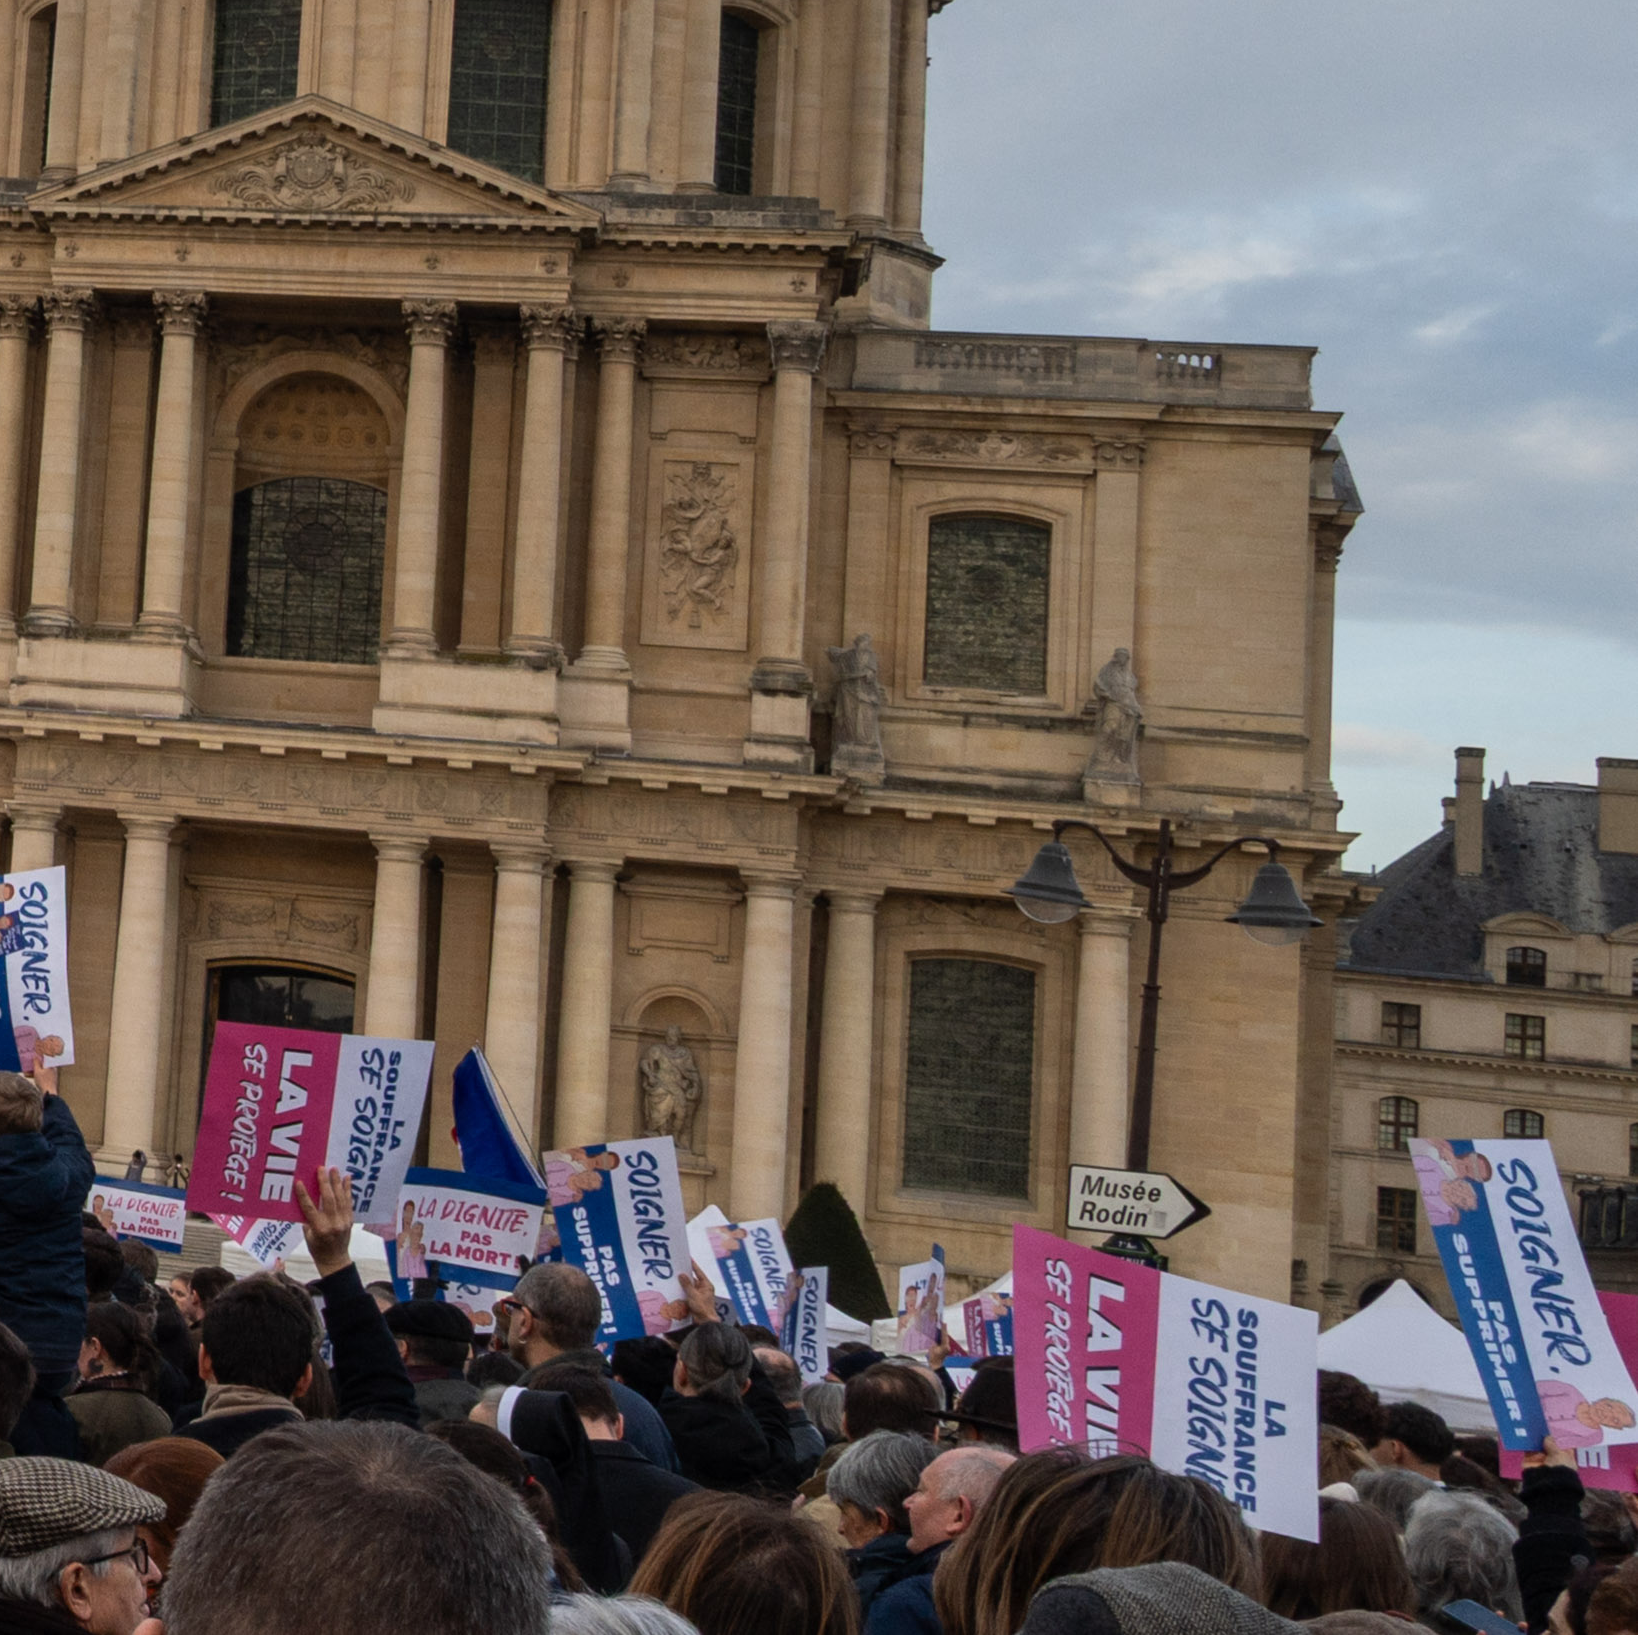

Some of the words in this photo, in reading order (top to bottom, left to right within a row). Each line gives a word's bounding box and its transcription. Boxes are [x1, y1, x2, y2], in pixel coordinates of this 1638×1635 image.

[242, 1042, 269, 1079] SE
[359, 1047, 385, 1090] SE
[276, 1048, 314, 1114] LA
[358, 1050, 402, 1213] SOUFFRANCE
[388, 1119, 405, 1151] LA
[259, 1121, 303, 1204] VIE
[107, 1194, 123, 1208] LA
[417, 1196, 438, 1219] LA
[1080, 1175, 1162, 1203] Musée
[121, 1222, 136, 1233] LA
[138, 1226, 172, 1239] MORT
[140, 1216, 160, 1226] PAS
[1078, 1201, 1149, 1228] Rodin
[429, 1240, 452, 1257] LA
[455, 1243, 512, 1269] MORT
[460, 1229, 493, 1246] PAS
[598, 1245, 621, 1287] PAS
[1045, 1256, 1073, 1304] SE
[743, 1281, 759, 1307] PAS
[1086, 1273, 1126, 1353] LA
[1191, 1297, 1231, 1353] SE
[1452, 1232, 1522, 1422] SUPPRIMER
[1489, 1300, 1517, 1365] PAS
[1085, 1366, 1121, 1460] VIE
[1233, 1308, 1259, 1513] SOUFFRANCE
[1264, 1399, 1287, 1438] LA
